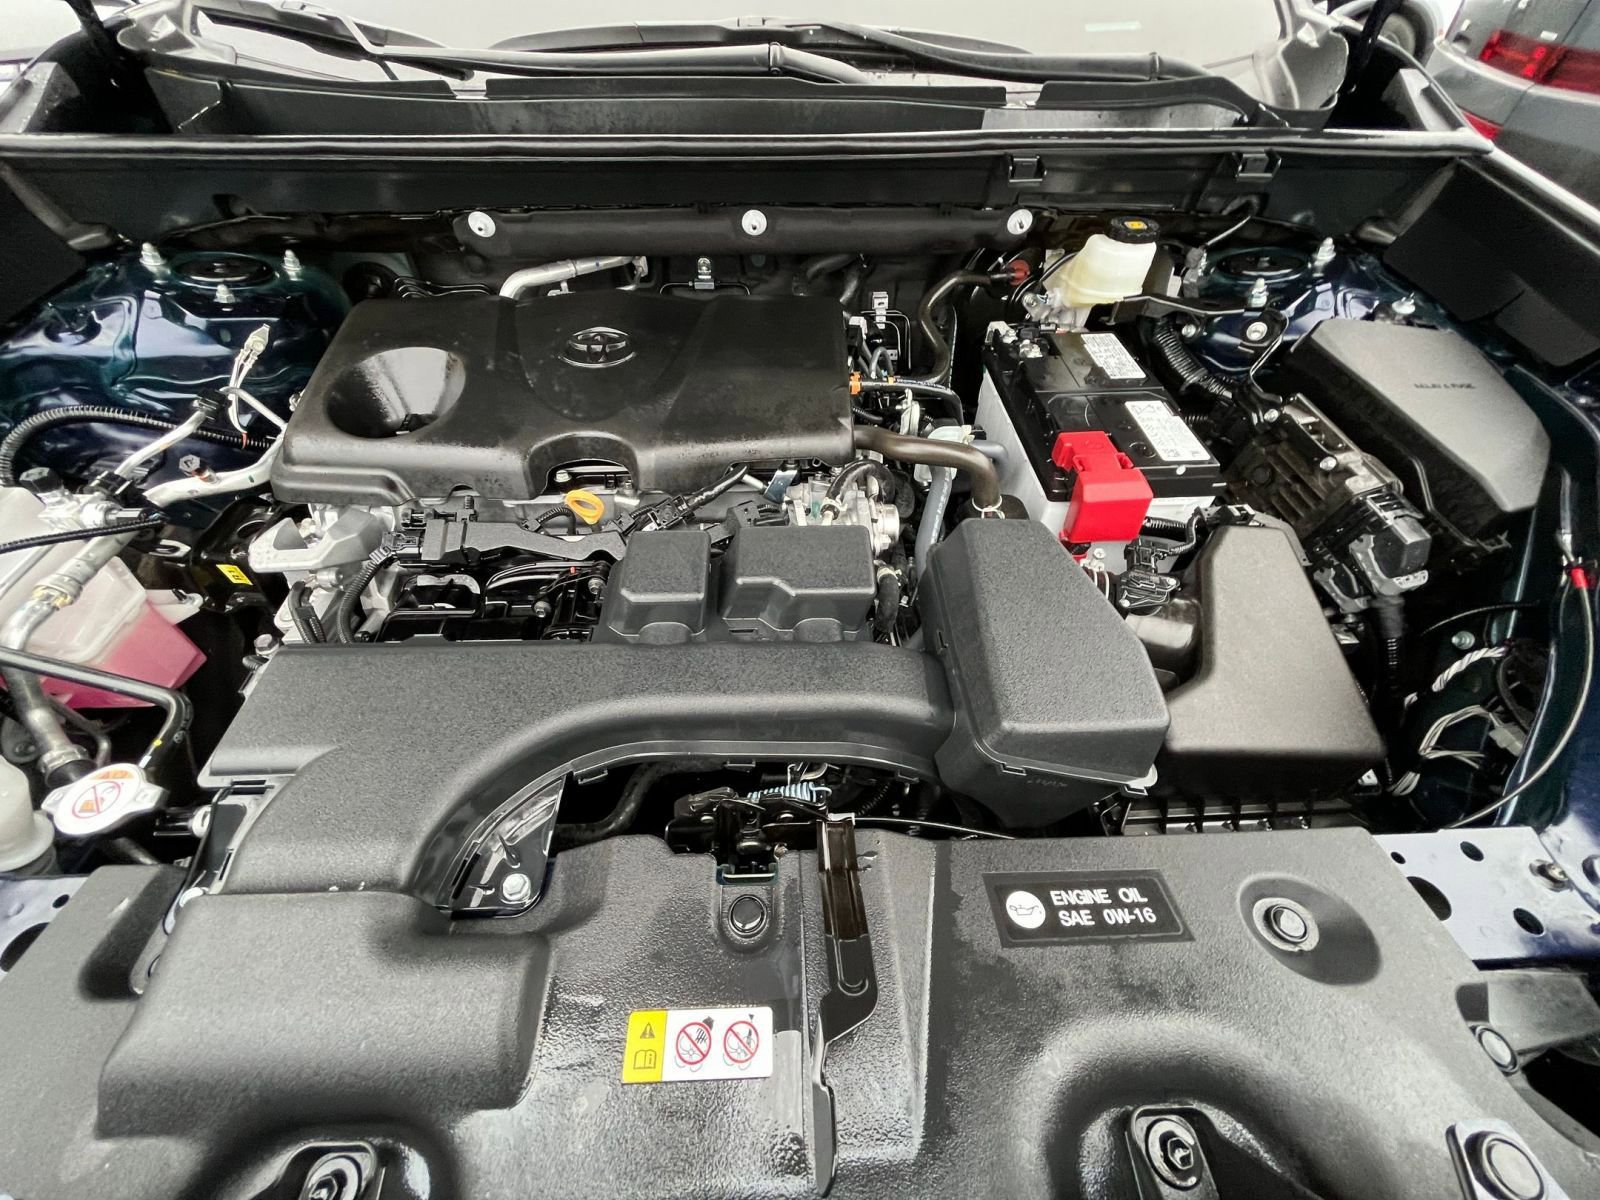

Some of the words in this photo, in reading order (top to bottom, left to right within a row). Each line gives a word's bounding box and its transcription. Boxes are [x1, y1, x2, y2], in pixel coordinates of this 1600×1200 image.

[1050, 888, 1112, 906] ENGINE
[1118, 887, 1148, 904] OIL
[1058, 909, 1095, 927] SAE
[1103, 907, 1157, 925] 0W-16
